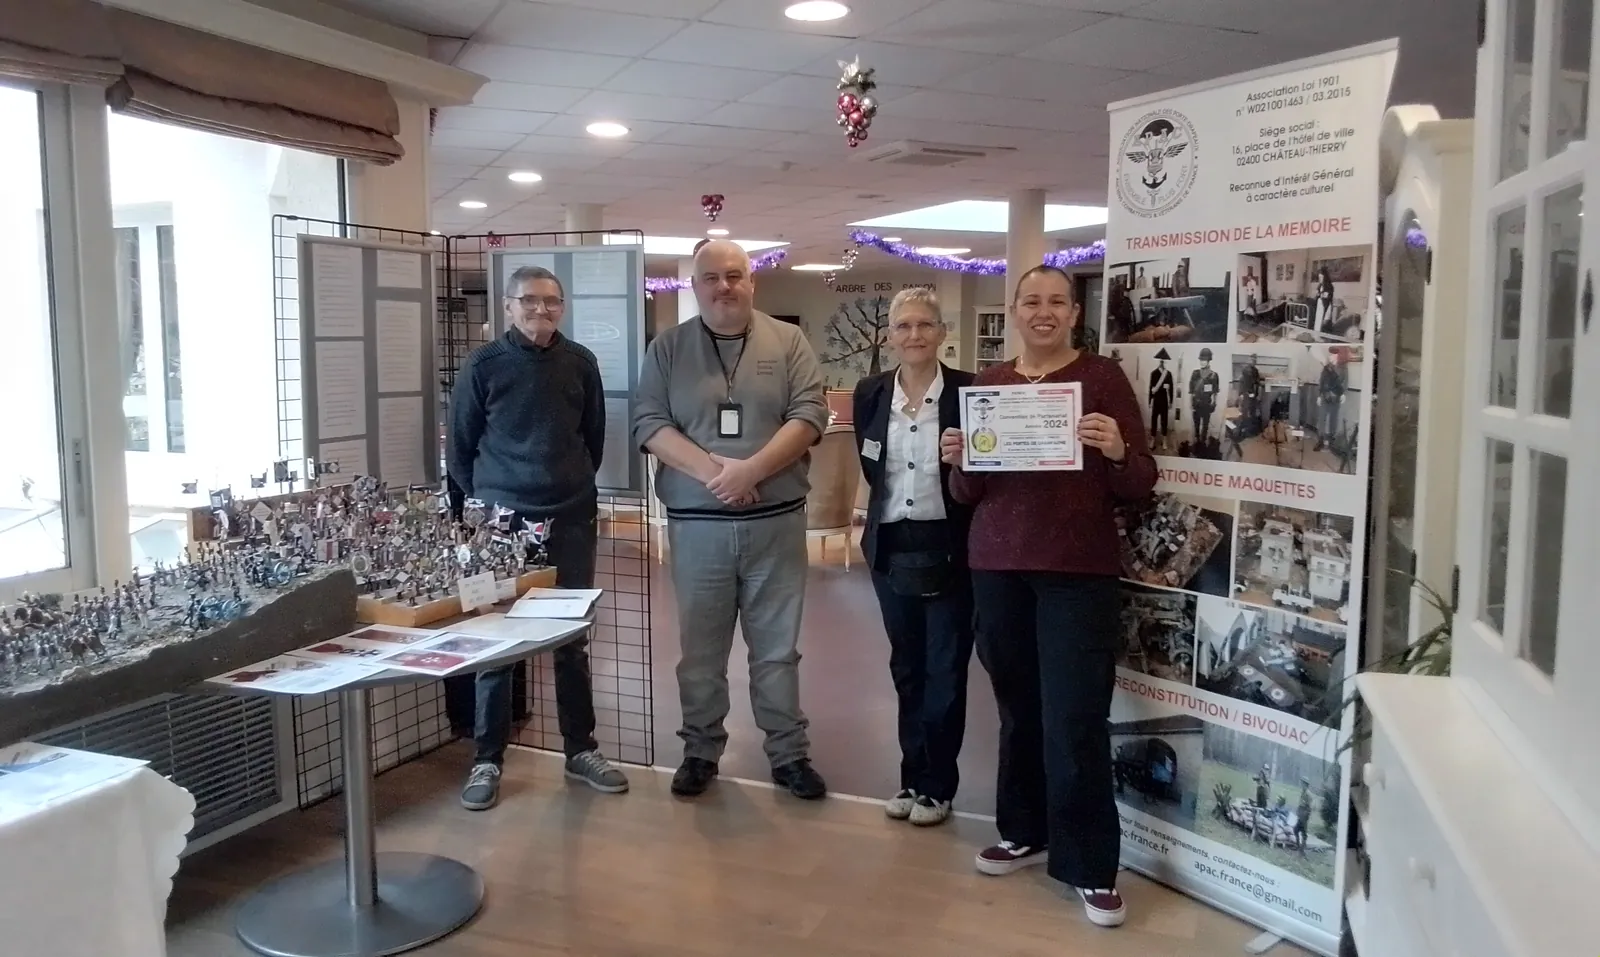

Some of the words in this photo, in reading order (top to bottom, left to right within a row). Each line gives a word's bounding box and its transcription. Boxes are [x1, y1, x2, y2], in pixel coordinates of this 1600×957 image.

[1246, 85, 1299, 102] Association
[1302, 82, 1314, 92] Loi
[1318, 75, 1340, 89] 1901
[1247, 96, 1303, 115] W021001463
[1312, 86, 1351, 102] 03.2015
[1232, 145, 1243, 156] 16,
[1244, 141, 1270, 154] place
[1273, 138, 1286, 149] de
[1317, 131, 1331, 141] de
[1333, 127, 1355, 139] ville
[1259, 126, 1286, 138] Siège
[1288, 119, 1315, 133] social
[1236, 155, 1260, 167] 02400
[1262, 141, 1347, 163] CHÂTEAU-THIERRY
[1229, 180, 1271, 193] Reconnue
[1273, 172, 1310, 187] d'Intérêt
[1312, 167, 1354, 181] Général
[1245, 192, 1252, 203] à
[1253, 188, 1298, 202] caractère
[1299, 183, 1334, 197] culturel
[1126, 229, 1230, 250] TRANSMISSION
[1234, 226, 1252, 241] DE
[1255, 224, 1274, 239] LA
[1278, 217, 1351, 237] MEMOIRE
[835, 284, 866, 293] ARBRE
[874, 282, 893, 292] DES
[1043, 419, 1068, 429] 2024
[1157, 468, 1199, 485] ATION
[1203, 472, 1223, 487] DE
[1228, 475, 1316, 499] MAQUETTES
[1114, 675, 1229, 720] RECONSTITUTION
[1233, 709, 1239, 721] /
[1242, 712, 1309, 745] BIVOUAC
[1119, 827, 1169, 855] ac-france.fr
[1133, 819, 1149, 833] tous
[1150, 827, 1210, 860] renseignements,
[1212, 854, 1275, 886] contactez-nous
[1194, 860, 1323, 922] apac.france@gmail.com
